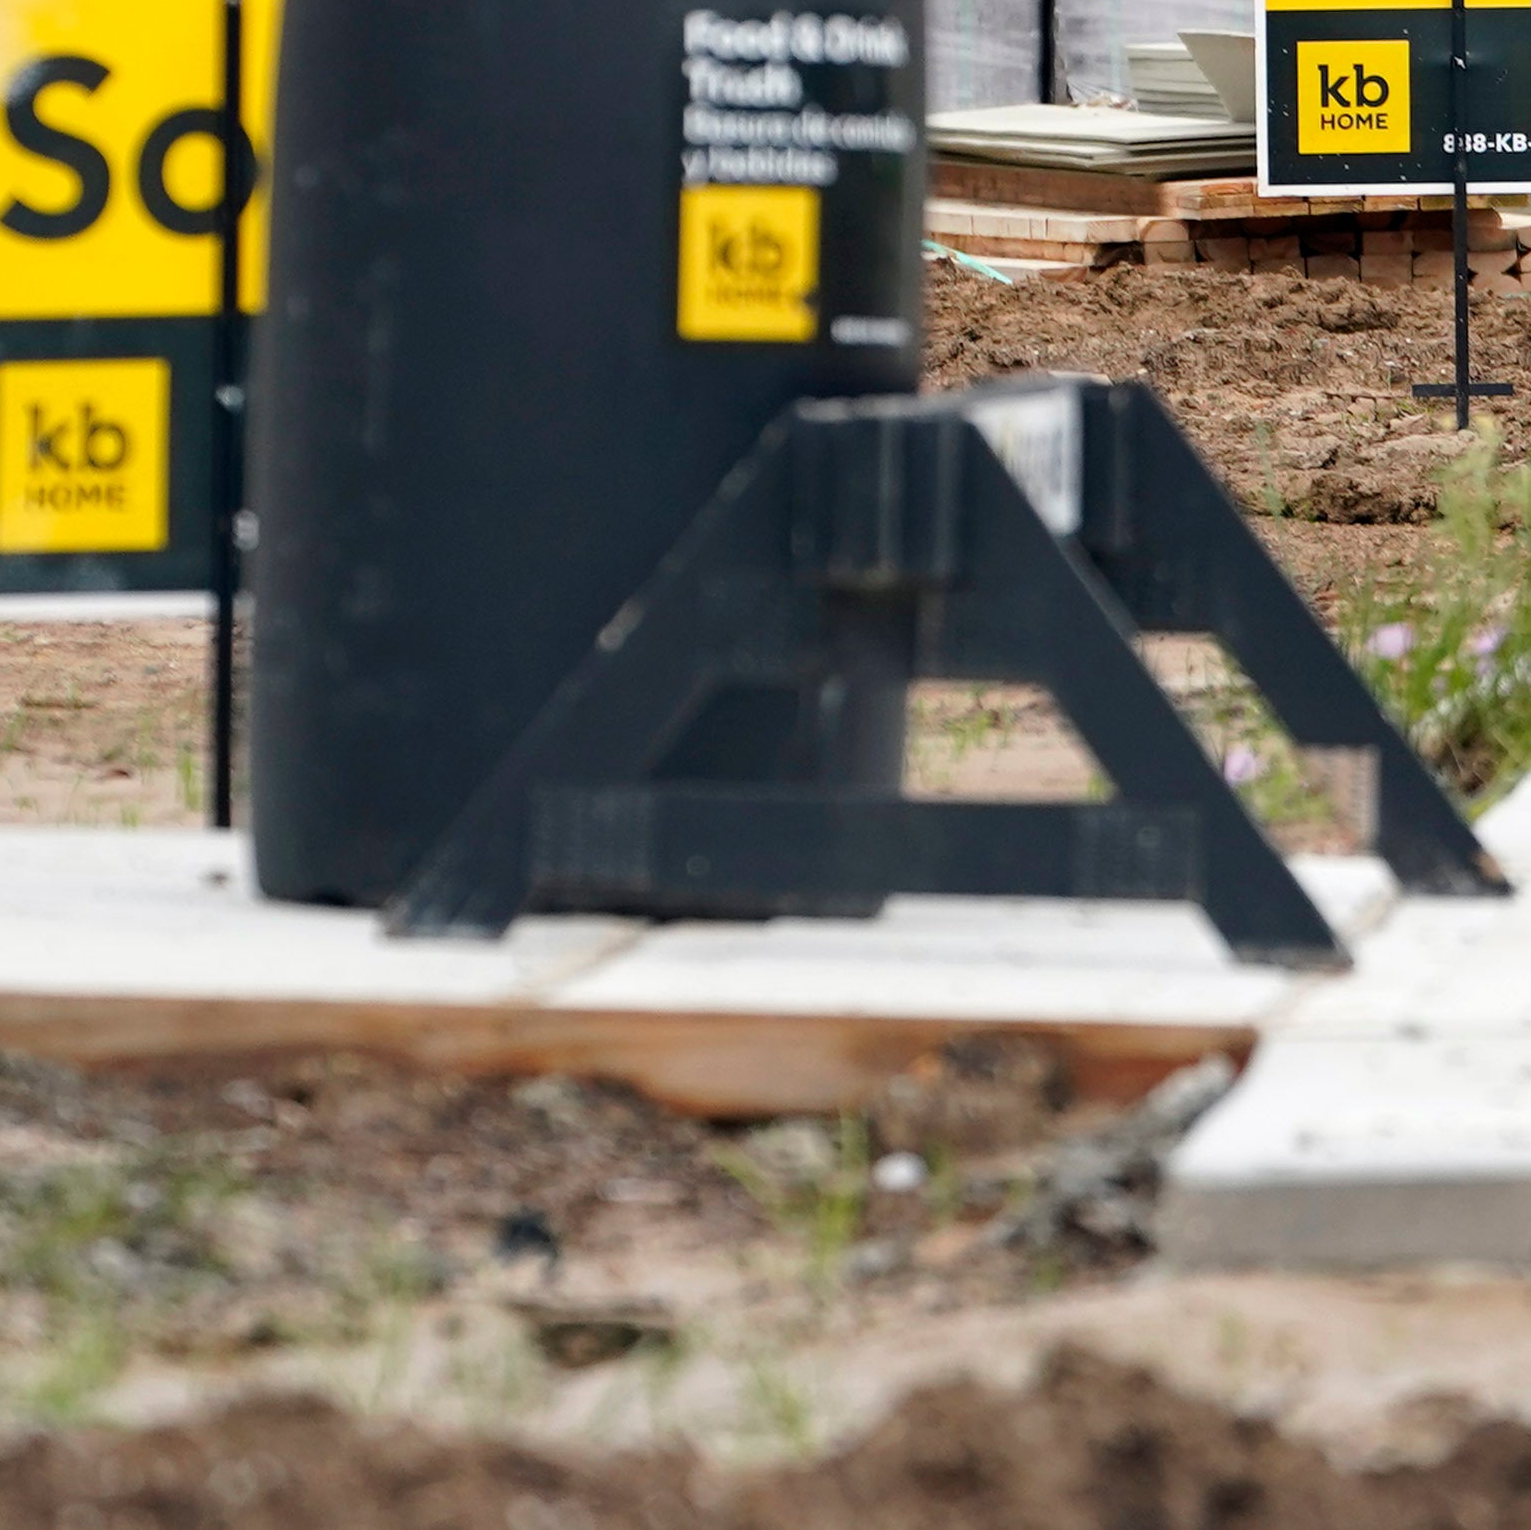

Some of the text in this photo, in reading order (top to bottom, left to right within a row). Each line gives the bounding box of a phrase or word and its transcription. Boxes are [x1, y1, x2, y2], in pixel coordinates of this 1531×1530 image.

[682, 10, 790, 62] Food
[1318, 64, 1390, 108] kb
[1320, 112, 1388, 130] HOME
[24, 402, 131, 473] kb
[24, 484, 127, 513] HOME
